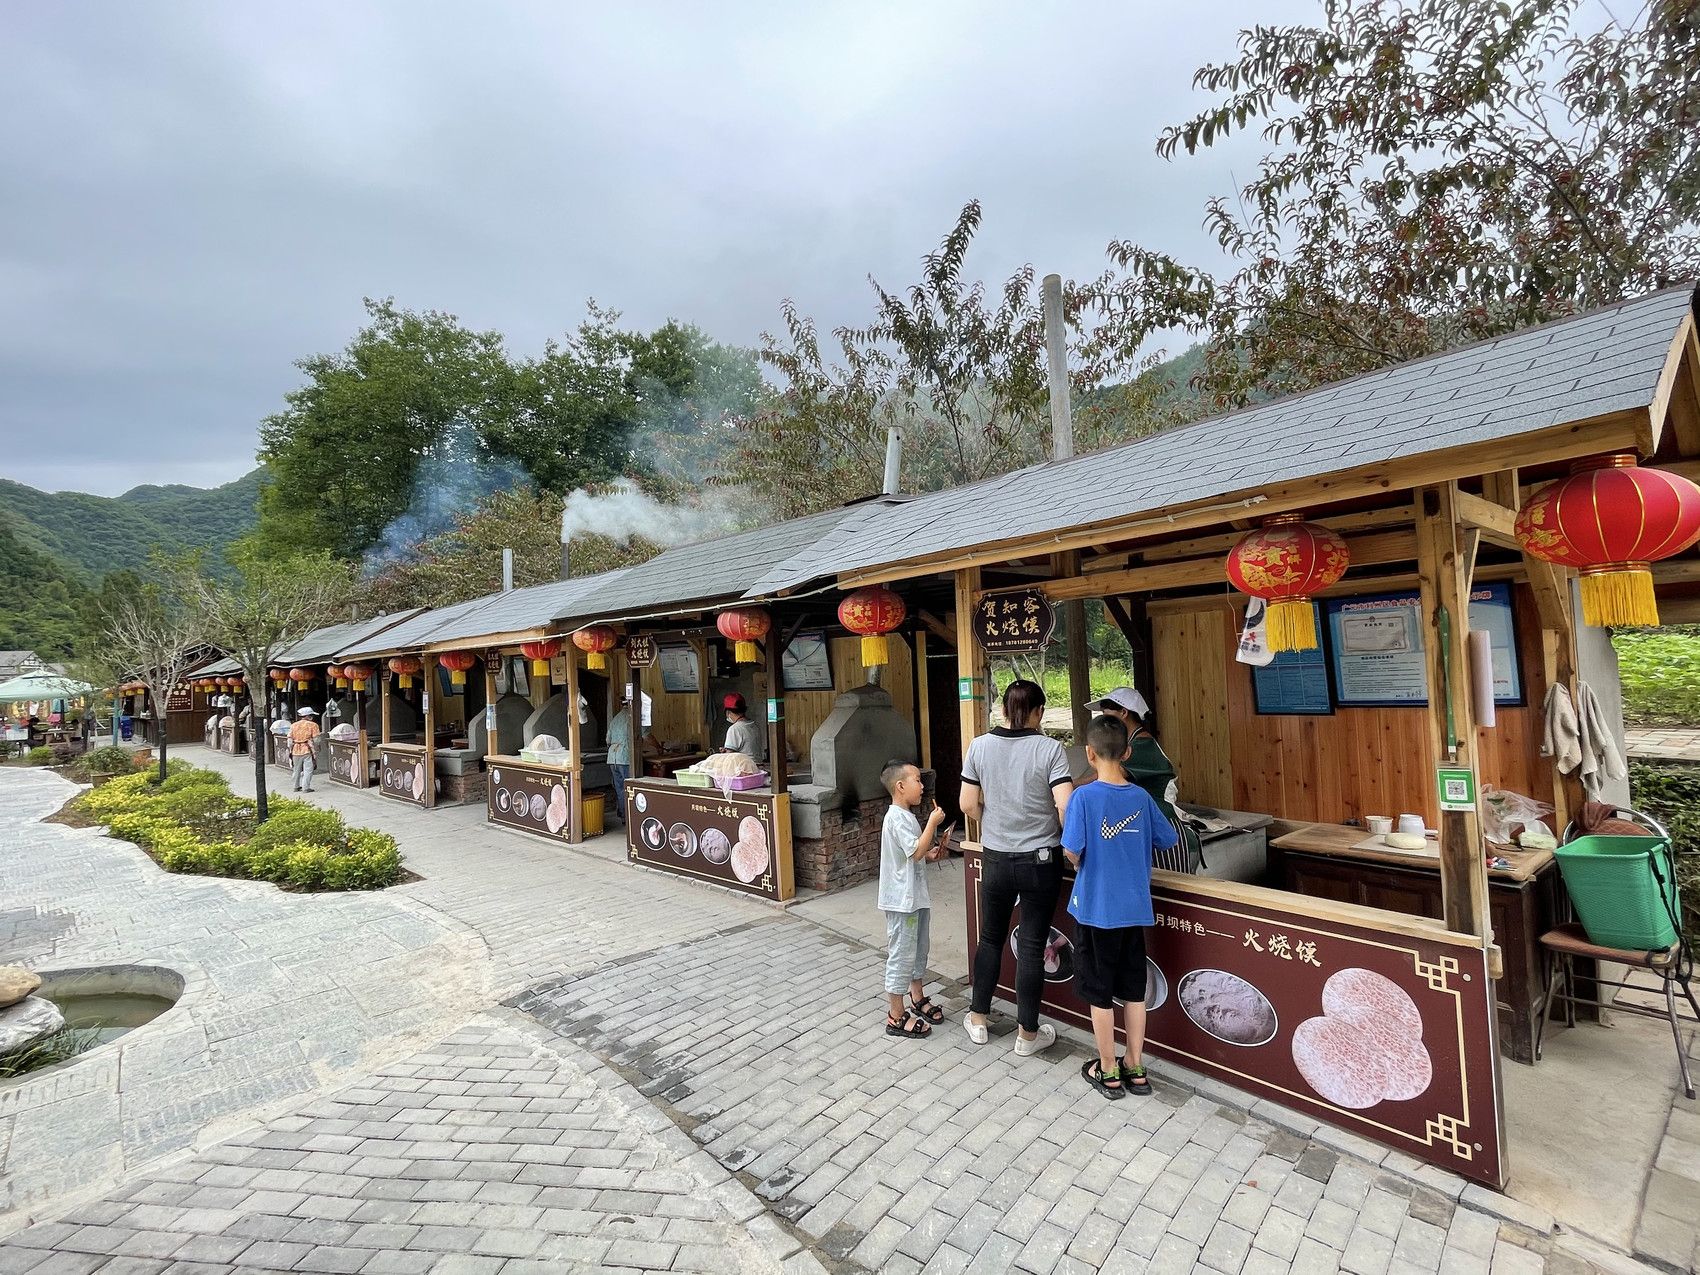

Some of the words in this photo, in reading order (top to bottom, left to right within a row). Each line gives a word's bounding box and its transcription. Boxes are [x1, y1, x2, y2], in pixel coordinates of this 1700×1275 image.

[986, 616, 1040, 636] 火烧馍
[1242, 928, 1322, 968] 火烧馍
